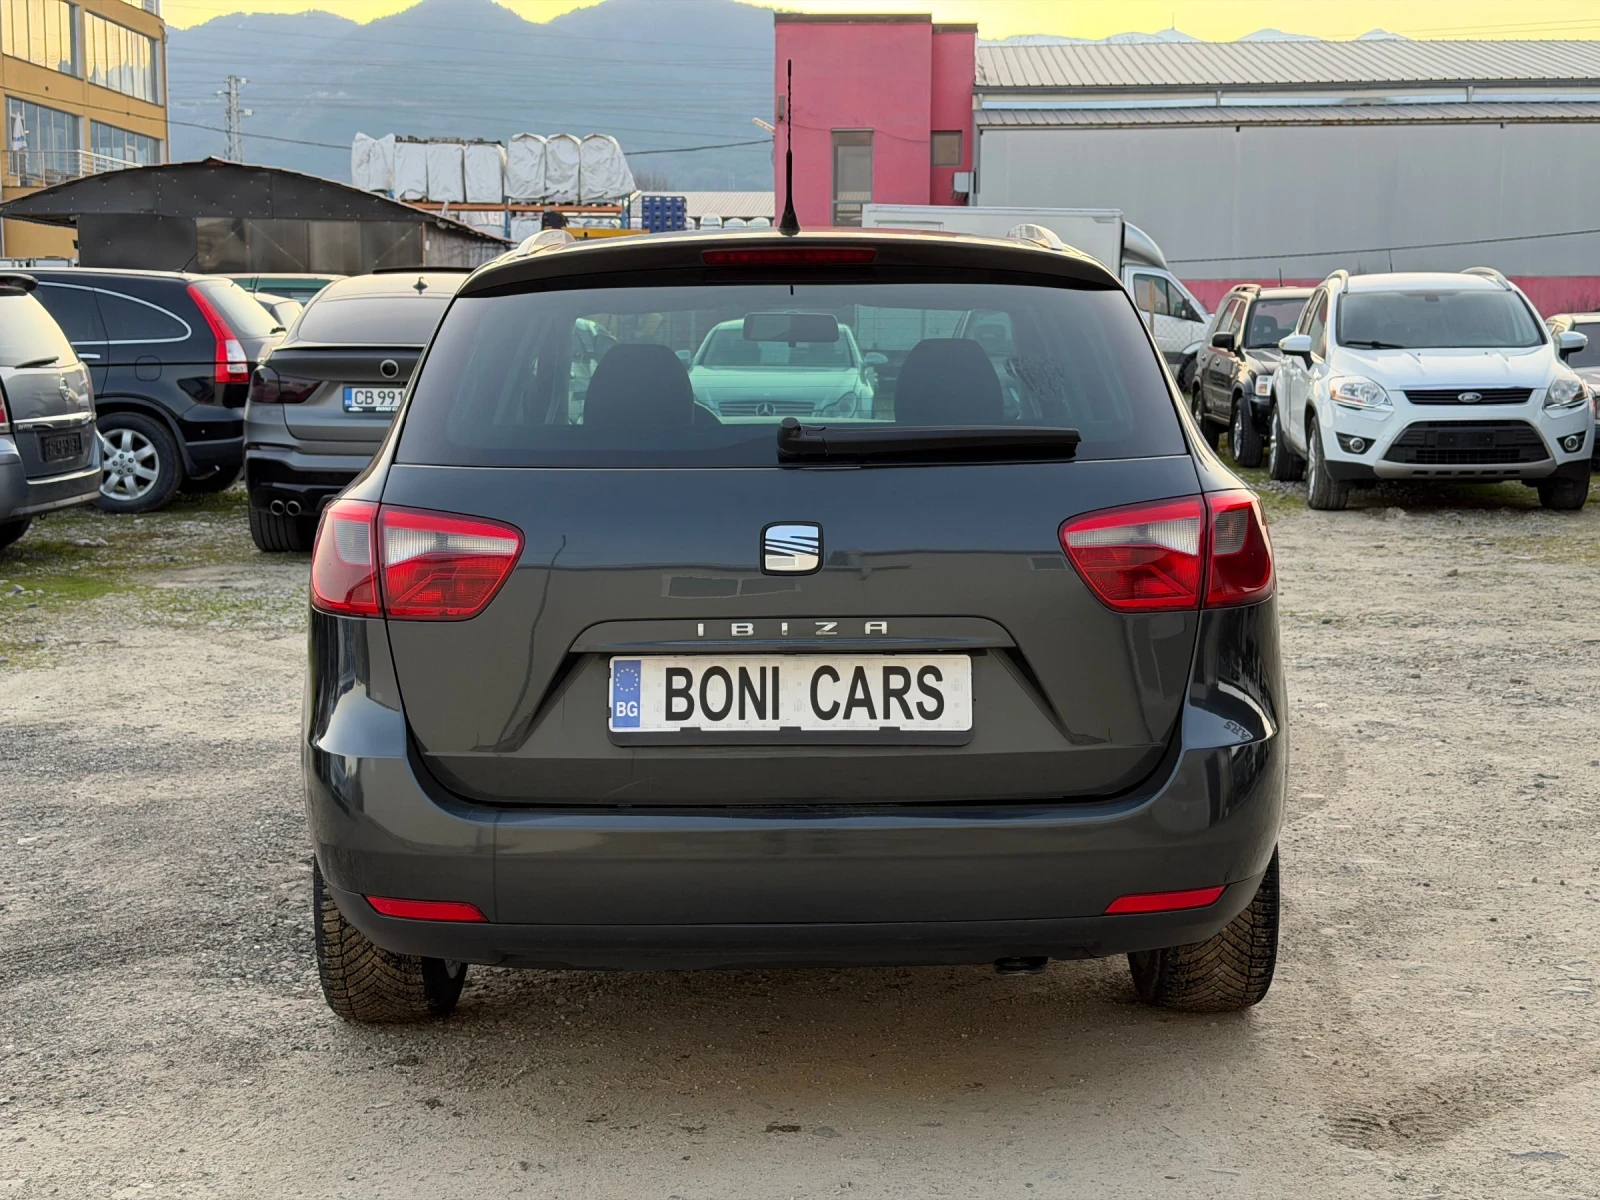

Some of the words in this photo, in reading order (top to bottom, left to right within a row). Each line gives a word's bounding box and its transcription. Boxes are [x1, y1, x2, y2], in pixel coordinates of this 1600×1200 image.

[354, 390, 374, 405] CB
[697, 621, 888, 637] IBIZA
[665, 666, 780, 721] BONI
[810, 665, 945, 721] CARS
[616, 701, 638, 717] BG
